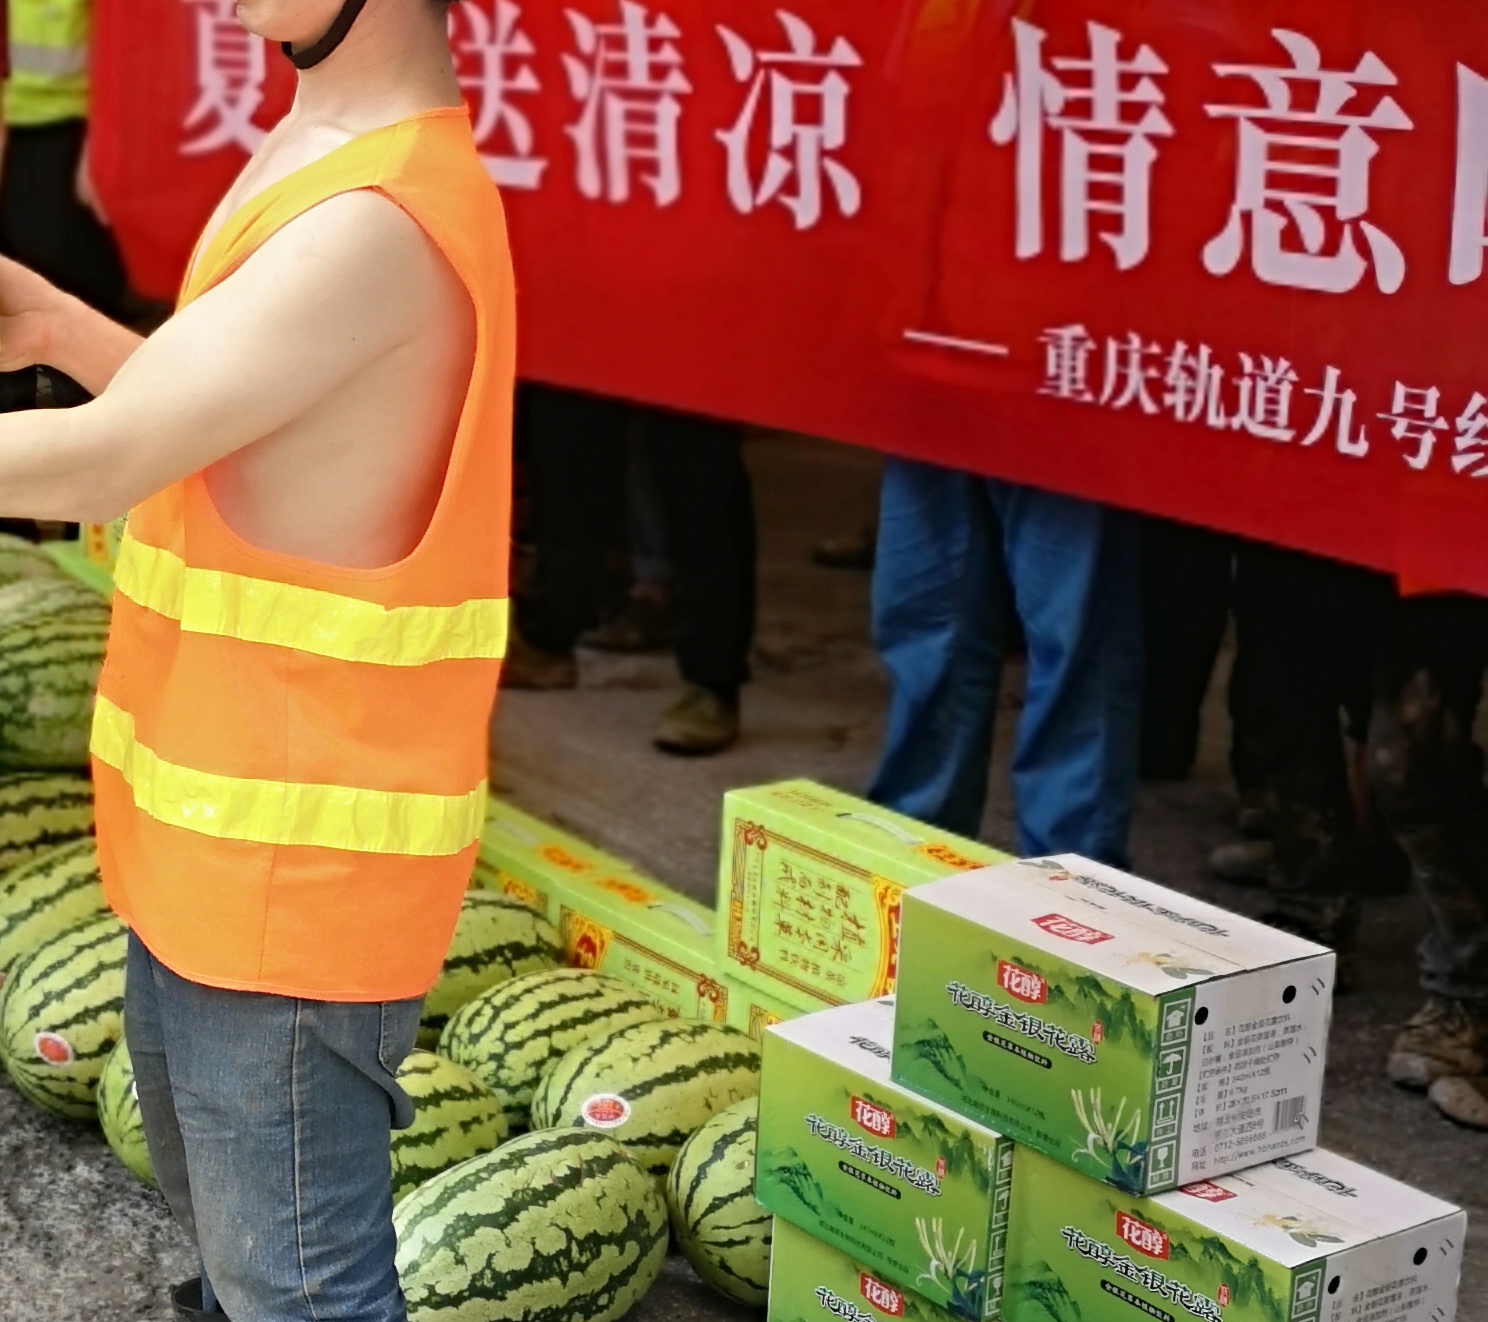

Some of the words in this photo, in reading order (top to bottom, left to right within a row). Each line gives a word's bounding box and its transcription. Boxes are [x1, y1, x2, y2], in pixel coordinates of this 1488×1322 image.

[1002, 965, 1041, 1002] 花醇
[944, 981, 1098, 1063] 花醇金银花露
[855, 1101, 890, 1137] 花醇
[804, 1112, 942, 1196] 花醇金银花露
[1120, 1216, 1164, 1258] 花醇
[864, 1279, 898, 1314] 花醇
